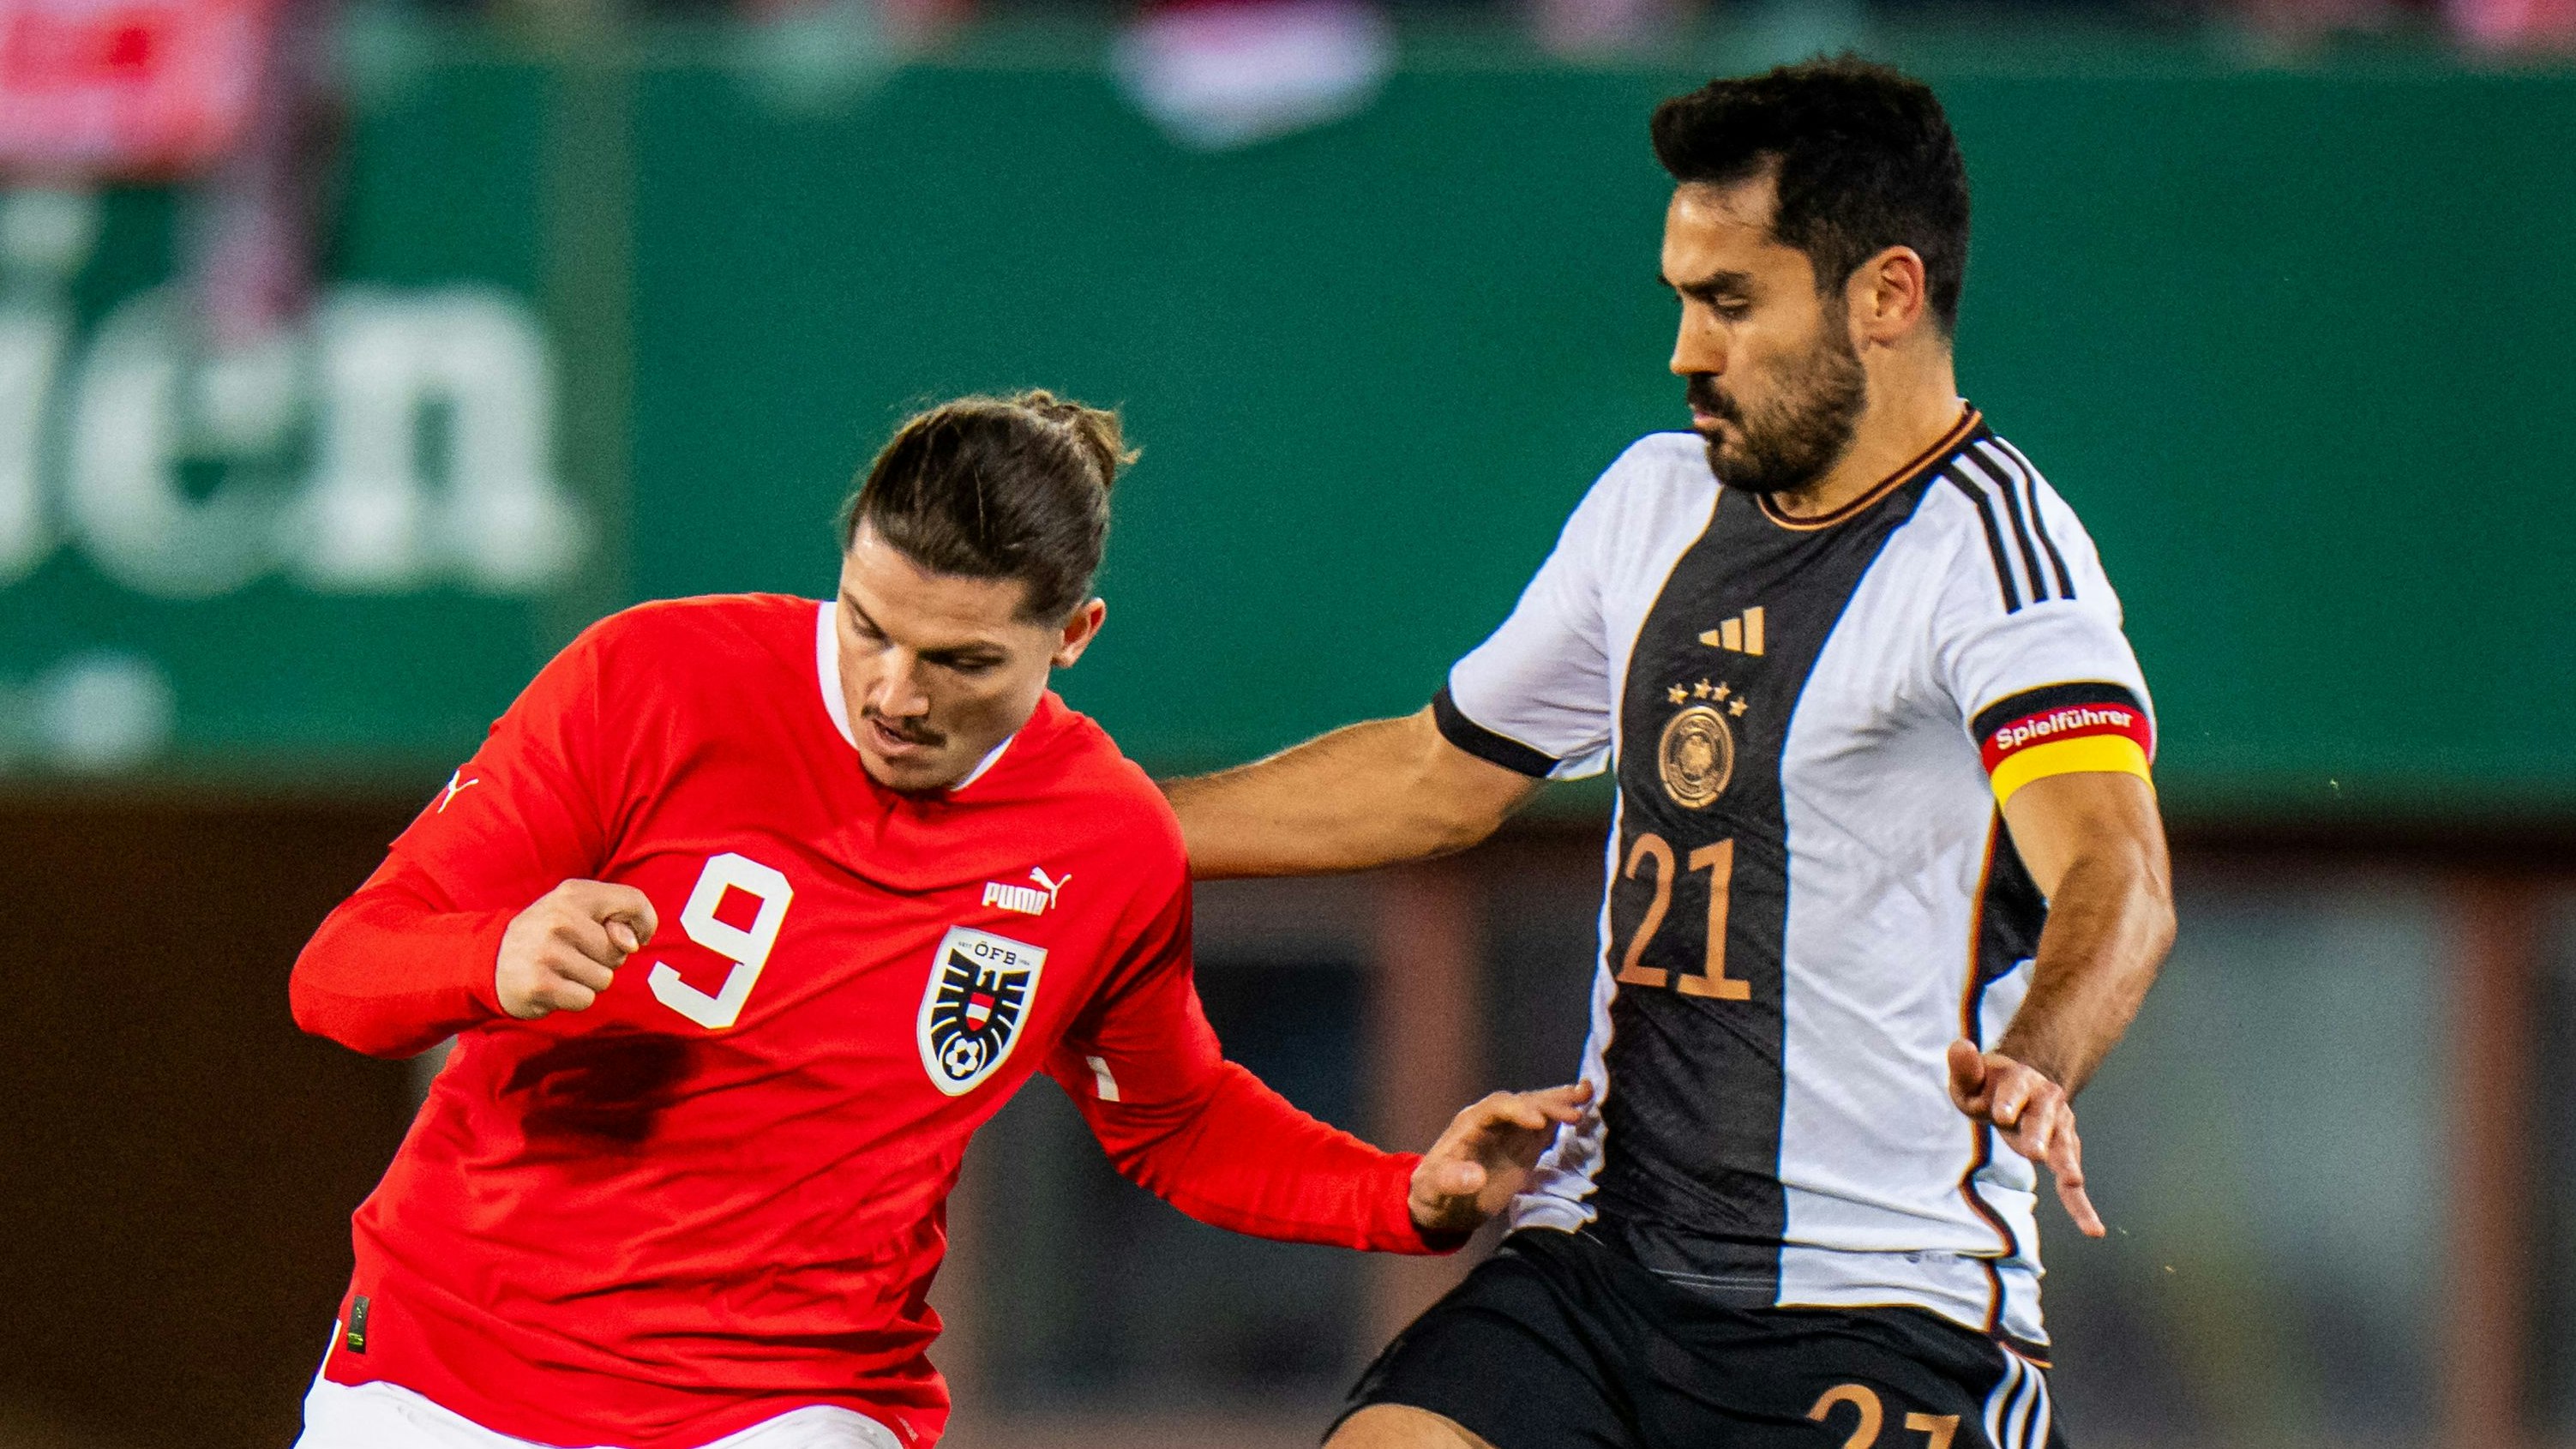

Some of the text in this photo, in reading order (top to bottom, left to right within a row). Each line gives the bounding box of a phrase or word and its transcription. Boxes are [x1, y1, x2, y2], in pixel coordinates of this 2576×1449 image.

[1995, 708, 2133, 750] Spielführer
[982, 881, 1049, 916] PUMA
[1617, 833, 1750, 1001] 21
[647, 851, 795, 1029] 9
[975, 941, 1017, 965] ÖFB
